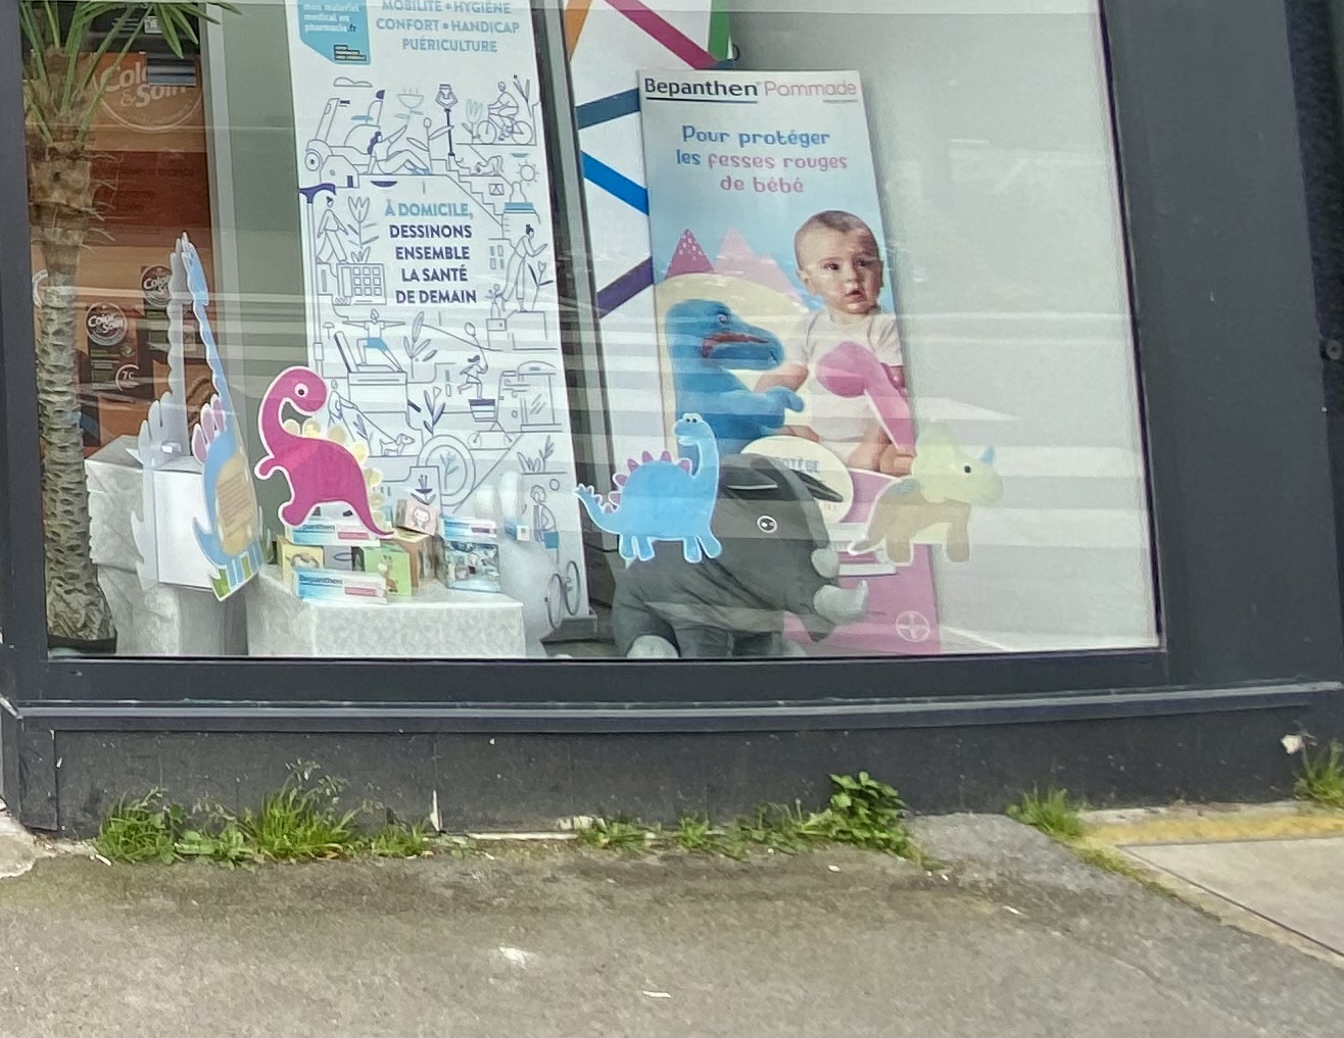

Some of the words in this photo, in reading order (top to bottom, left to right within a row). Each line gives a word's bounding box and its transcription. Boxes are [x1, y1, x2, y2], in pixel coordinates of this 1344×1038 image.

[375, 17, 440, 32] CONFORT
[450, 19, 520, 34] HANDICAP
[402, 35, 499, 53] PUÉRICULTURE
[100, 61, 148, 92] Col
[764, 80, 858, 97] Pommade
[682, 125, 730, 143] Pour
[739, 129, 831, 149] protéger
[676, 149, 701, 166] les
[708, 152, 775, 170] fesses
[783, 155, 848, 172] rouges
[720, 175, 745, 192] de
[753, 176, 804, 194] bébé
[385, 199, 396, 216] À
[398, 202, 474, 220] DOMICILE,
[389, 224, 473, 239] DESSINONS
[395, 246, 471, 260] ENSEMBLE
[401, 267, 421, 282] LA
[422, 263, 469, 282] SANTÉ
[395, 290, 416, 304] DE
[419, 290, 477, 304] DEMAIN
